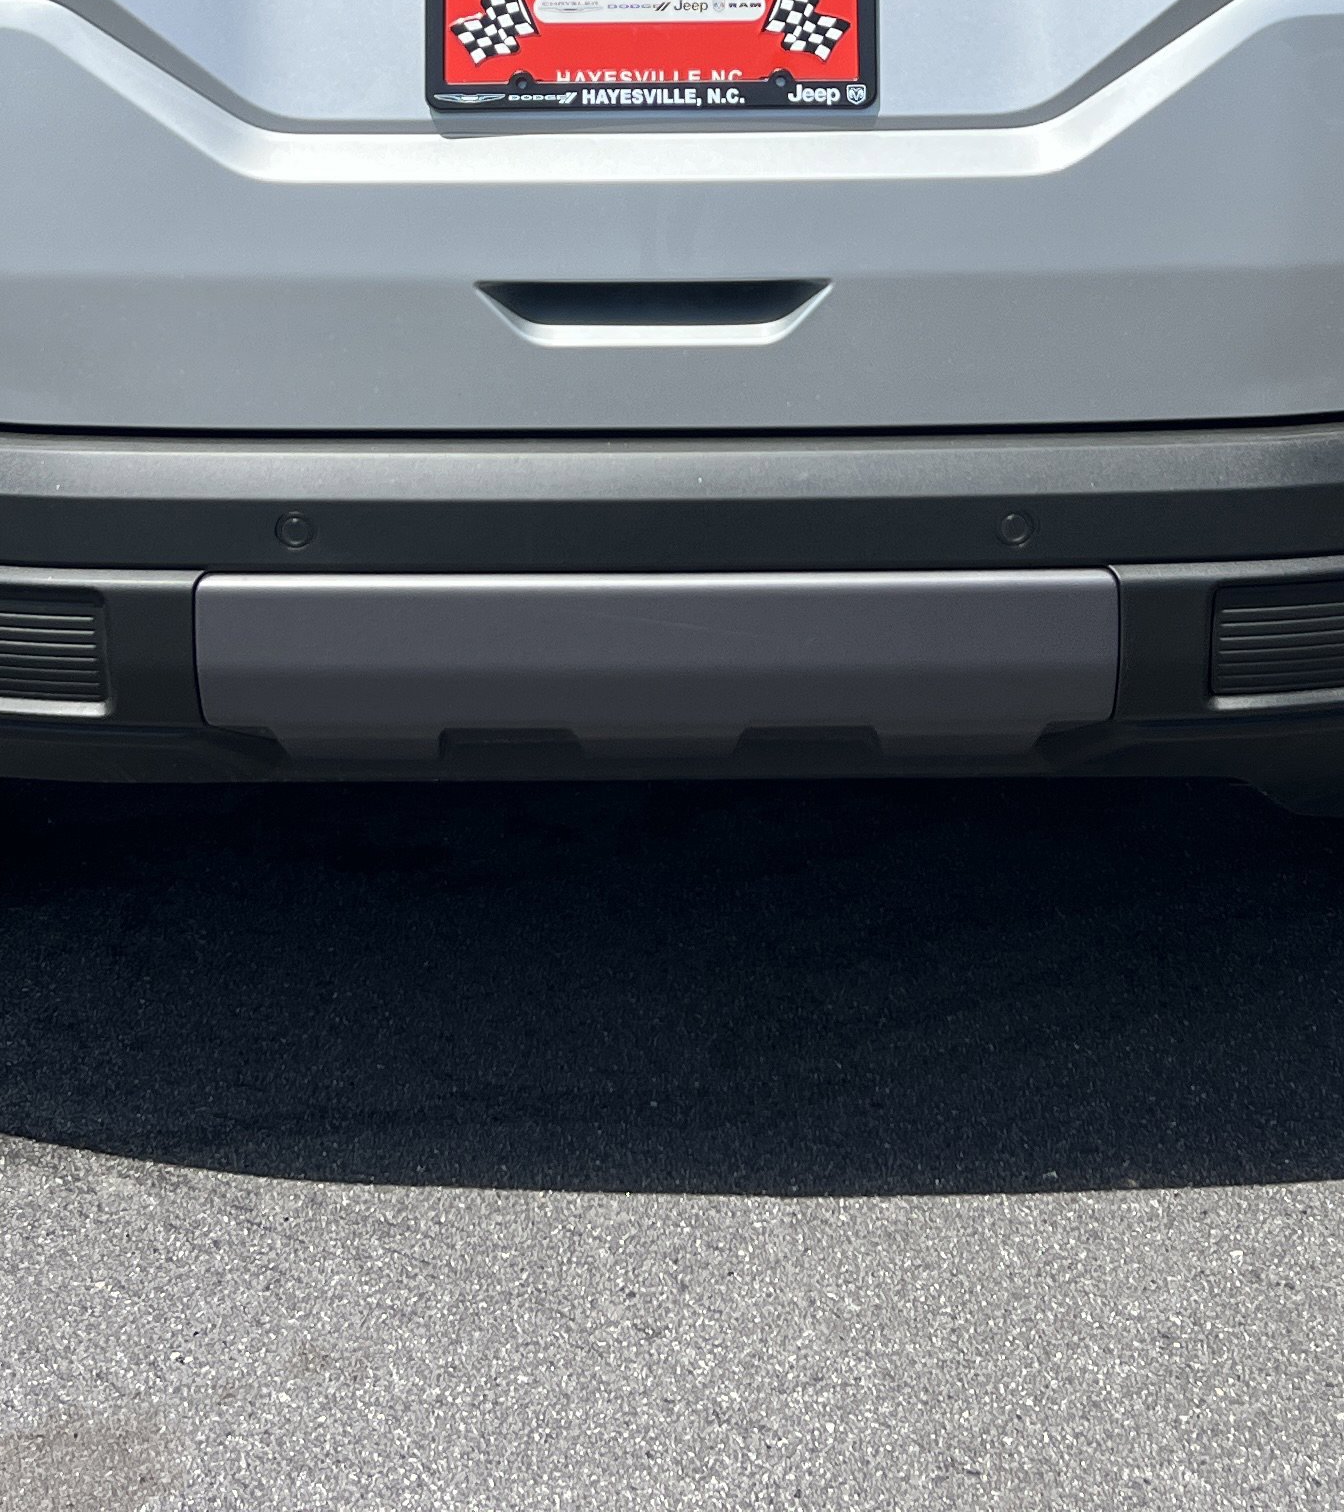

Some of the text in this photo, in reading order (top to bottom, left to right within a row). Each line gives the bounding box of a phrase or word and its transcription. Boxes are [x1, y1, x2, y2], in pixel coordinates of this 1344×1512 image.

[582, 88, 702, 107] HAYESVILLE,
[707, 88, 746, 104] N.C.
[787, 84, 841, 106] Jeep
